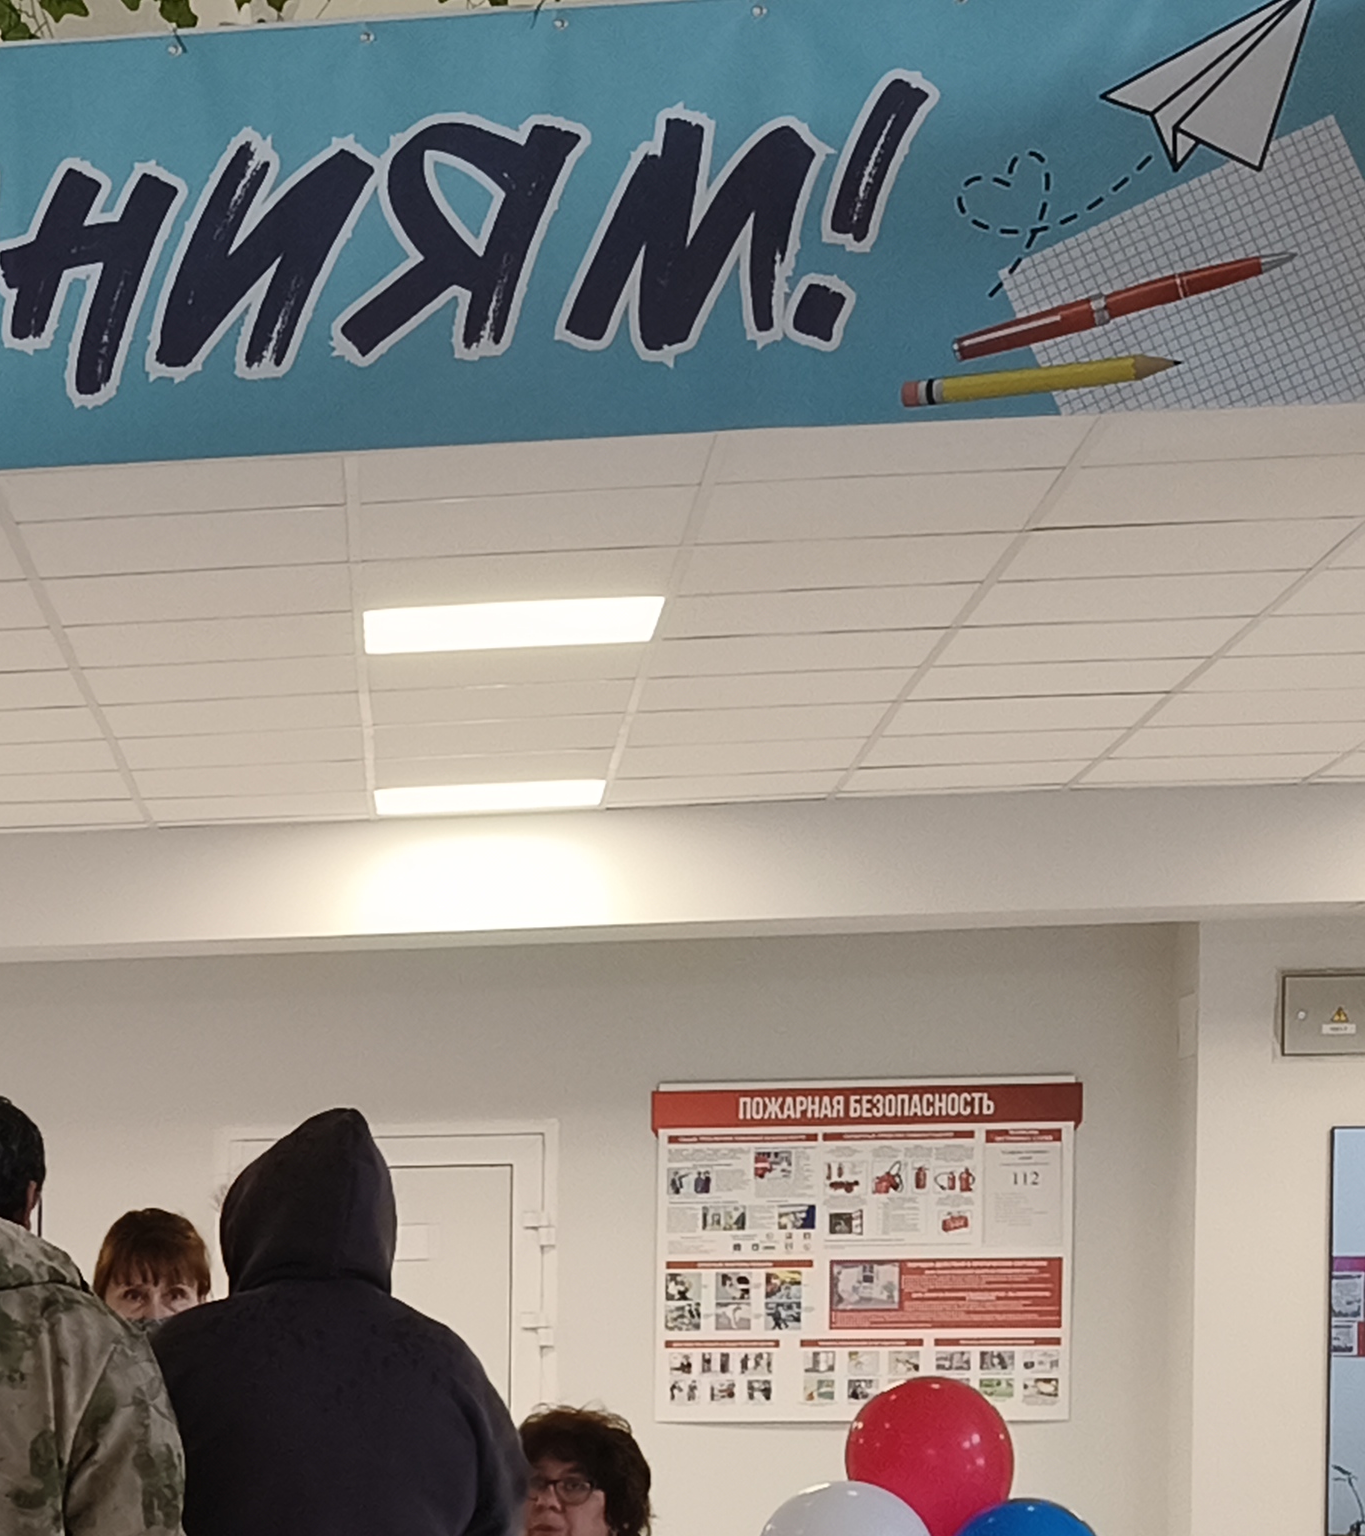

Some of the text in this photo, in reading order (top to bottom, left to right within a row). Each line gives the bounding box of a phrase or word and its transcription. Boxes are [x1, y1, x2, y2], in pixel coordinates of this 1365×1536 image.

[738, 1092, 995, 1120] ПОЖАРНАЯ БЕЗОПАСНОСТЬ
[1012, 1172, 1040, 1186] 112
